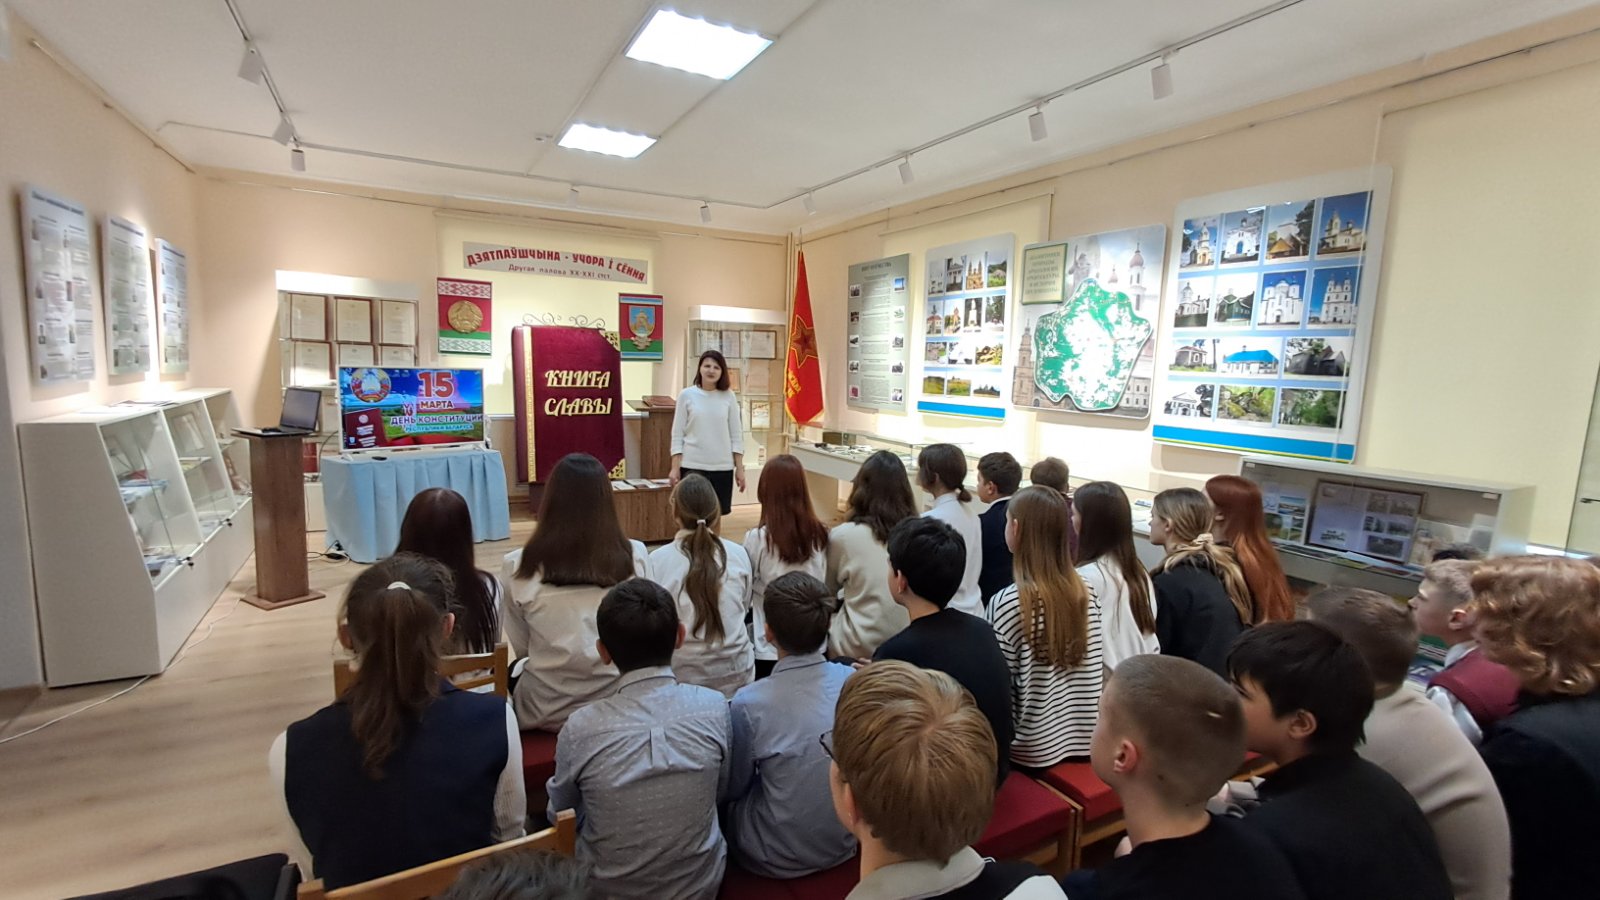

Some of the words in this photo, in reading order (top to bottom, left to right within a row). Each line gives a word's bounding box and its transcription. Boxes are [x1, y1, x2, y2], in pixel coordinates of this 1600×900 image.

[508, 263, 535, 273] Другая
[572, 253, 605, 268] УЧОРА
[616, 261, 646, 282] СЁННЯ
[418, 371, 454, 398] 15
[544, 369, 611, 389] КНИГА
[420, 400, 454, 409] МАРТА
[544, 397, 613, 417] СЛАВЫ
[391, 416, 416, 426] ДЕНЬ
[418, 414, 484, 424] КОНСТИТУЦИИ
